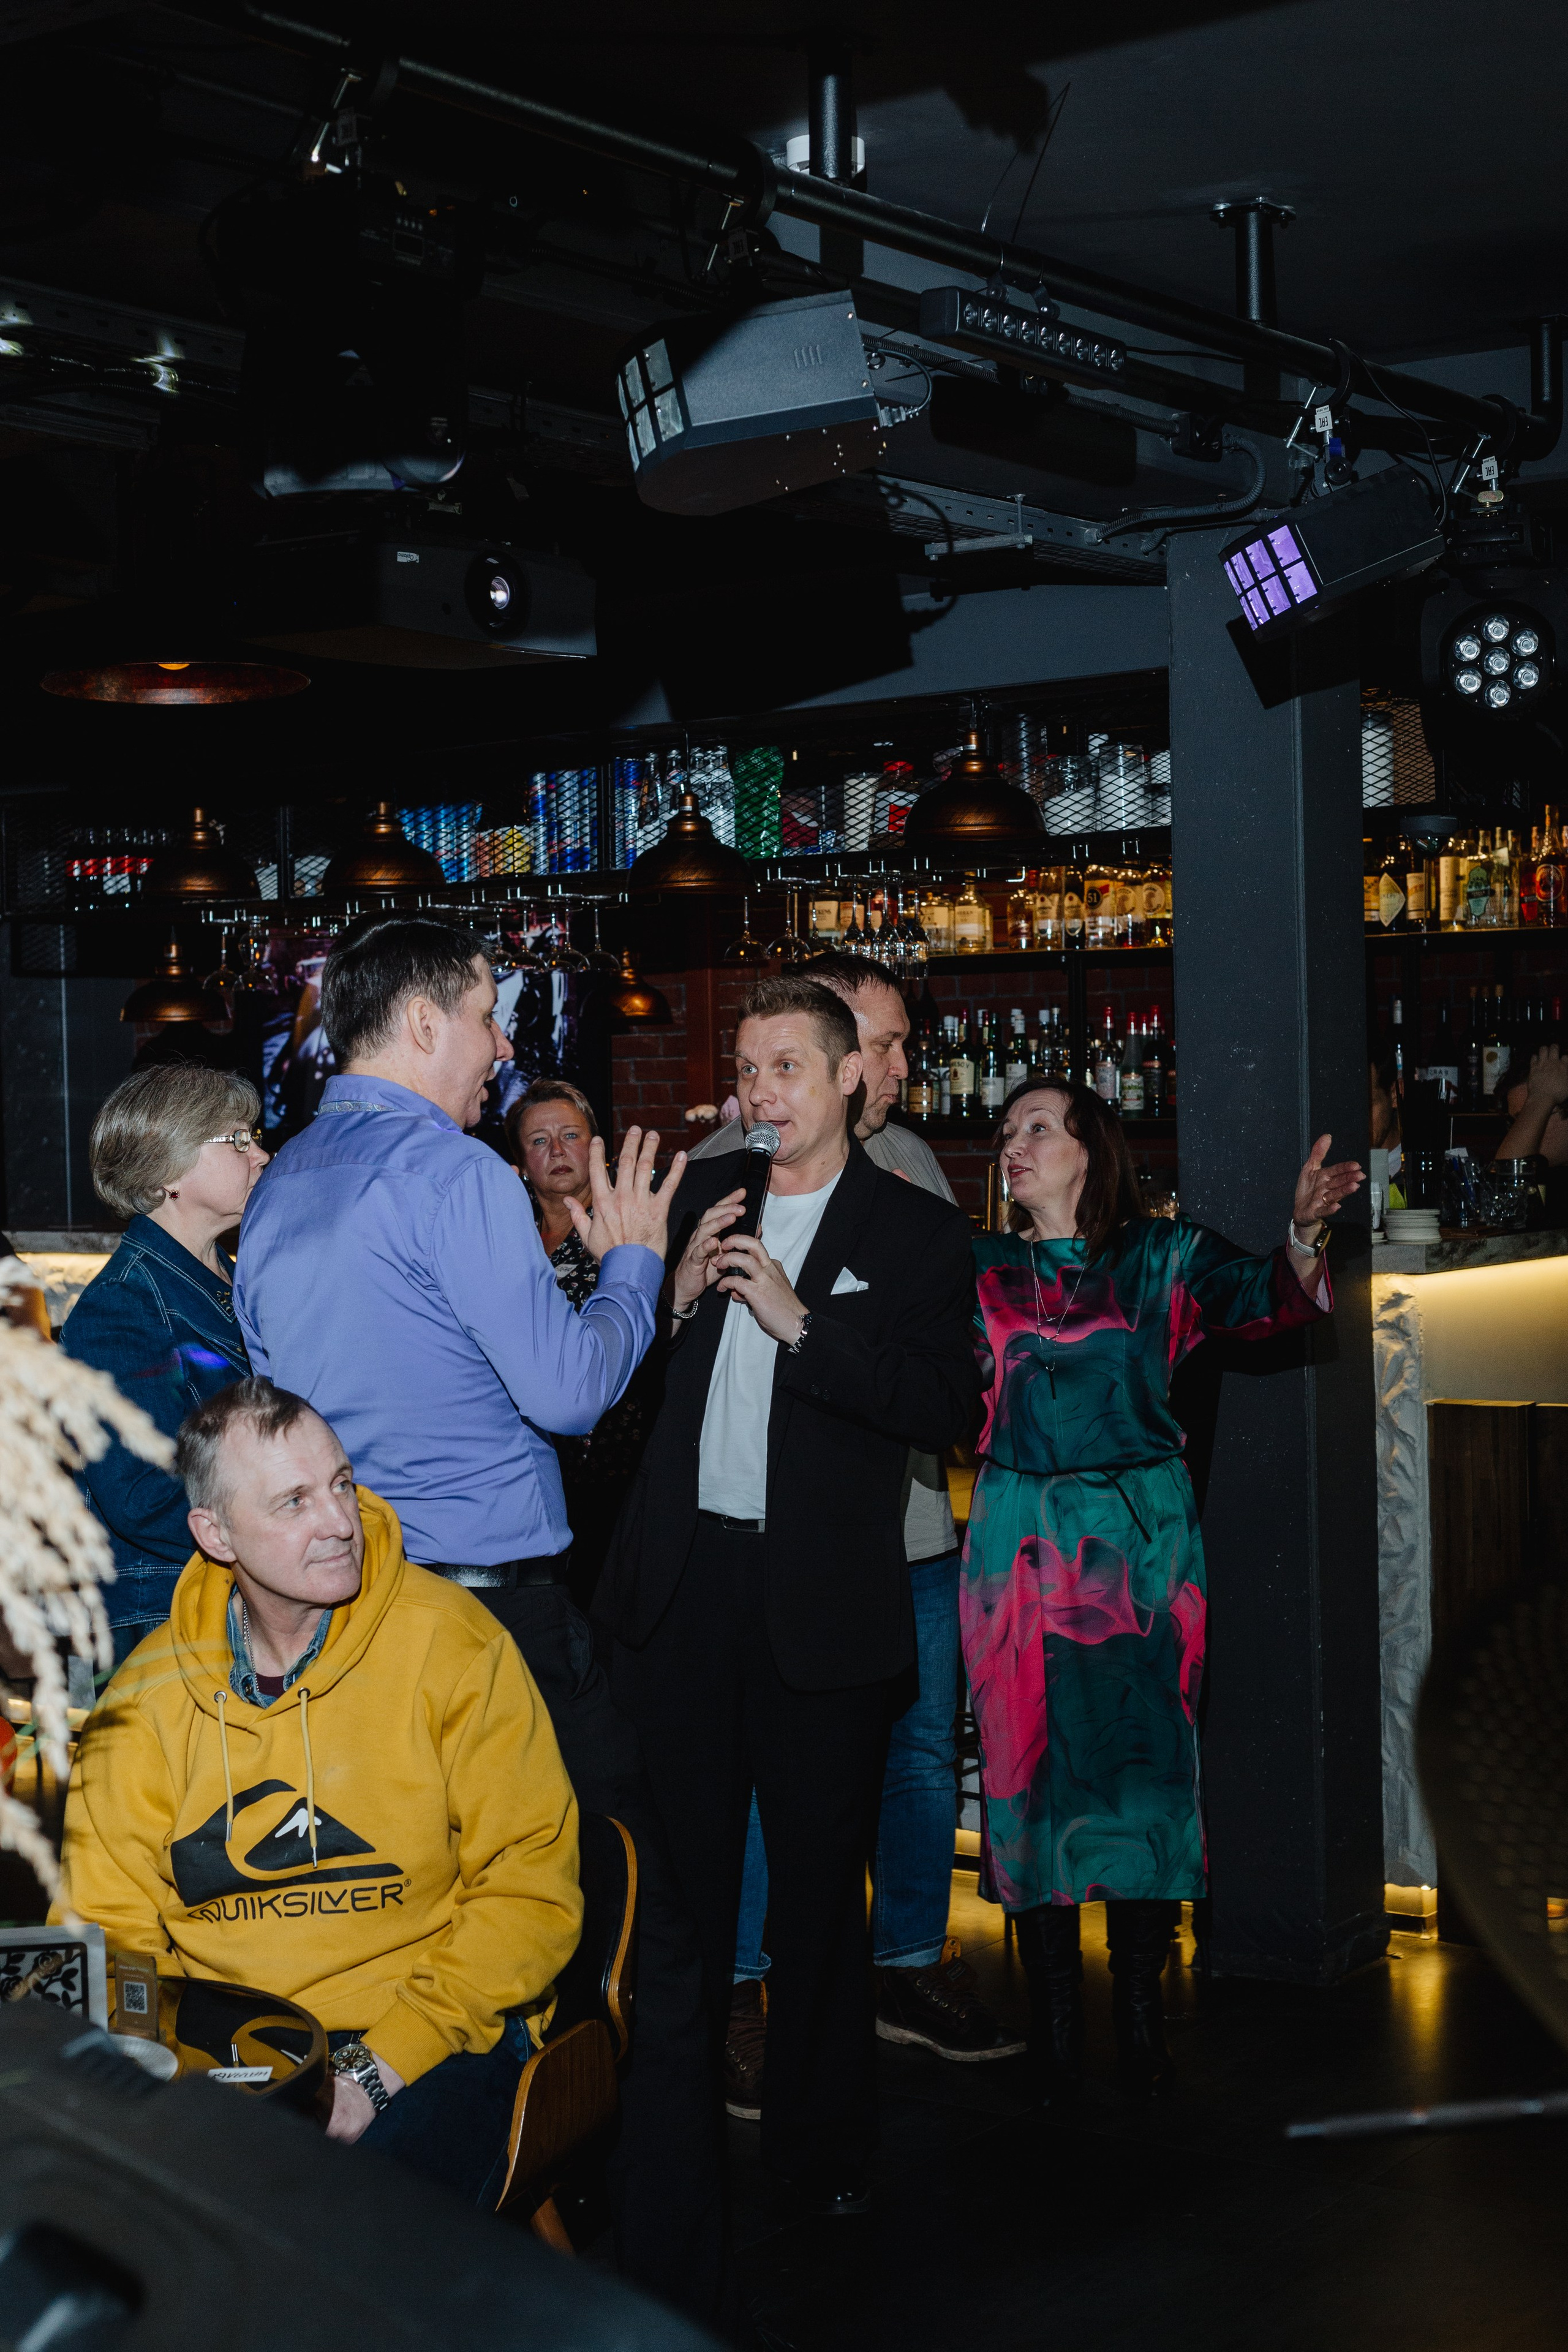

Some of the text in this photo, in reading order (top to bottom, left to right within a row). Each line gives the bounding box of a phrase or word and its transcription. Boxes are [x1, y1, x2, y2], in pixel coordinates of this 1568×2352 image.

[1318, 416, 1329, 428] EAC
[1485, 466, 1494, 477] EAC
[1087, 892, 1098, 903] 51
[186, 1882, 404, 1924] QUIKSILVER
